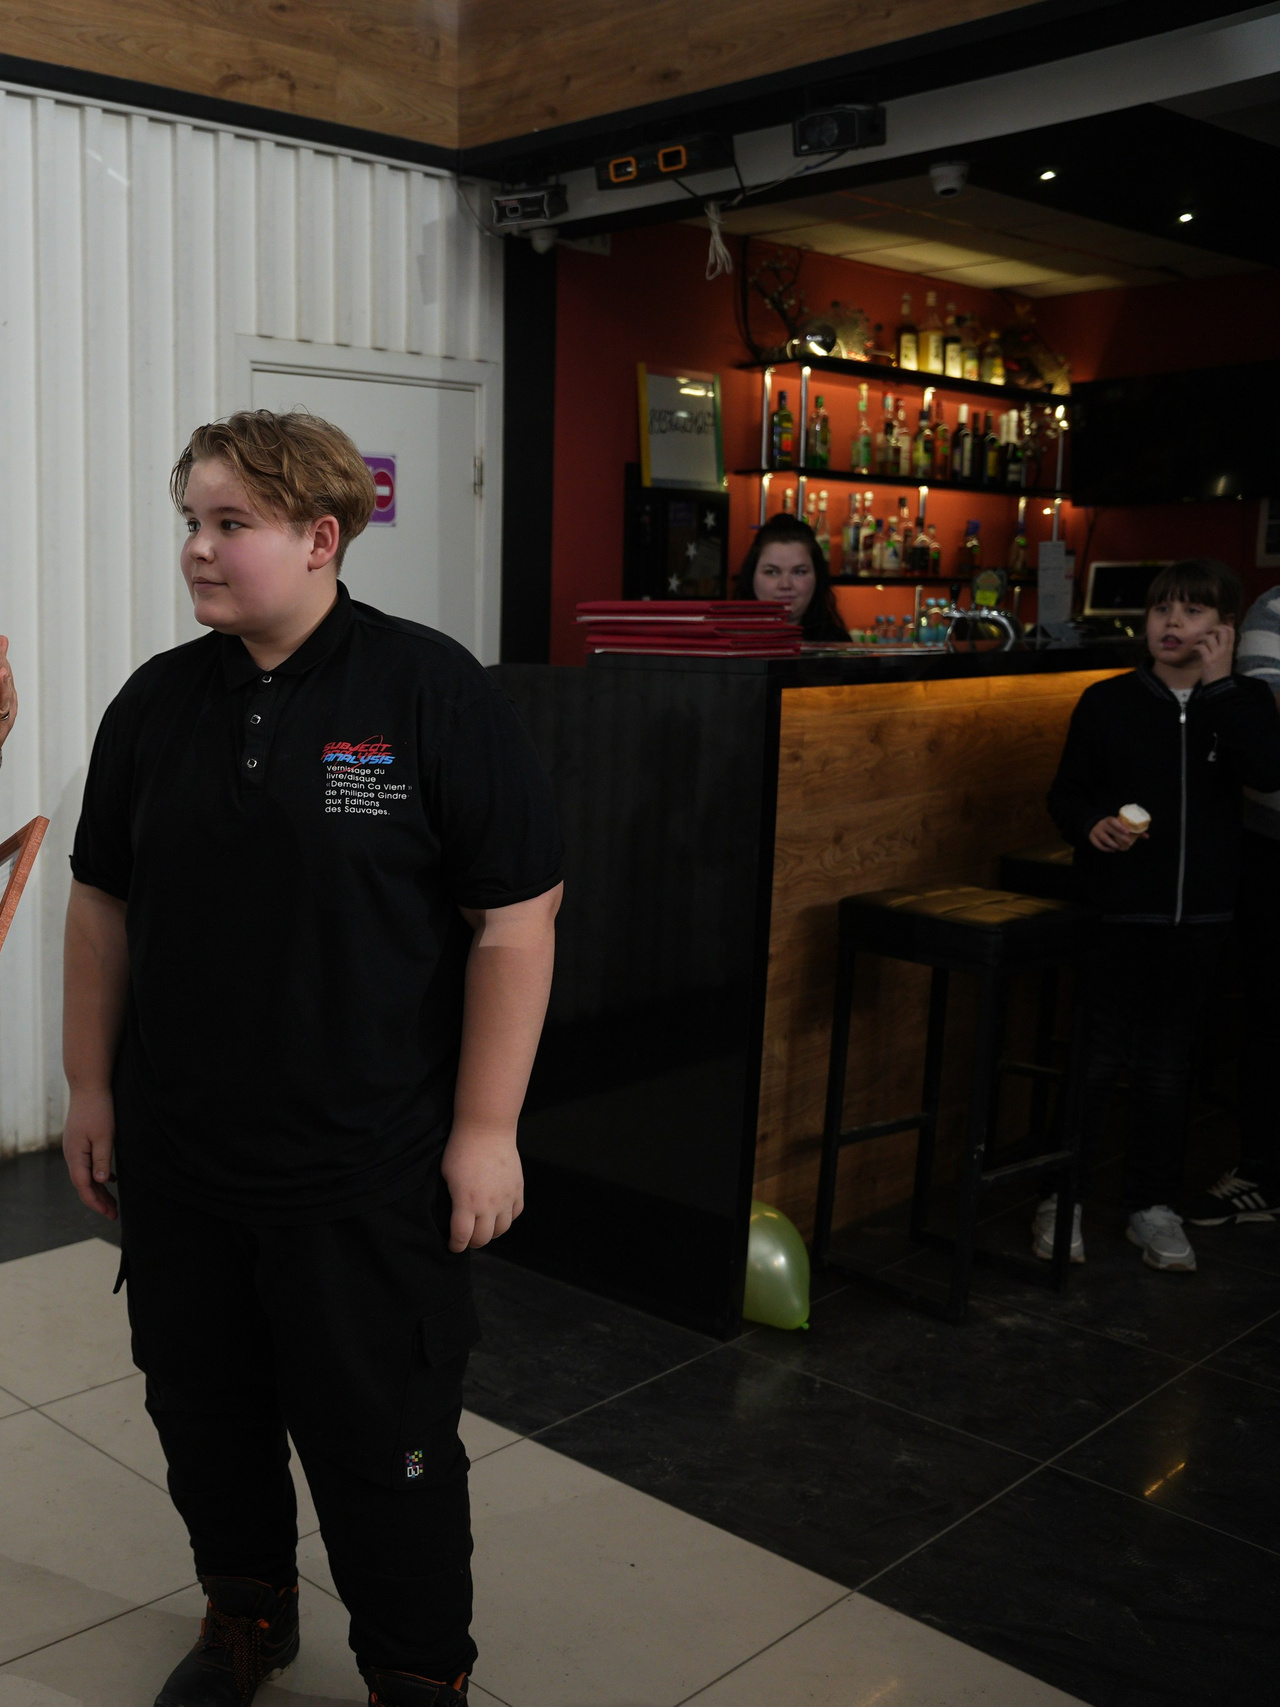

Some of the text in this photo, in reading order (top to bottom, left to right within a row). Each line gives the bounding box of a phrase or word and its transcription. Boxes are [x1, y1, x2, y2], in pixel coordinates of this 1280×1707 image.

[323, 753, 395, 765] ANALYSIS
[326, 765, 371, 775] Vernissage
[326, 773, 376, 783] livre/disque
[340, 789, 375, 798] Philippe
[377, 792, 407, 800] Gindre
[345, 797, 380, 807] Editions
[344, 805, 391, 816] Sauvages.
